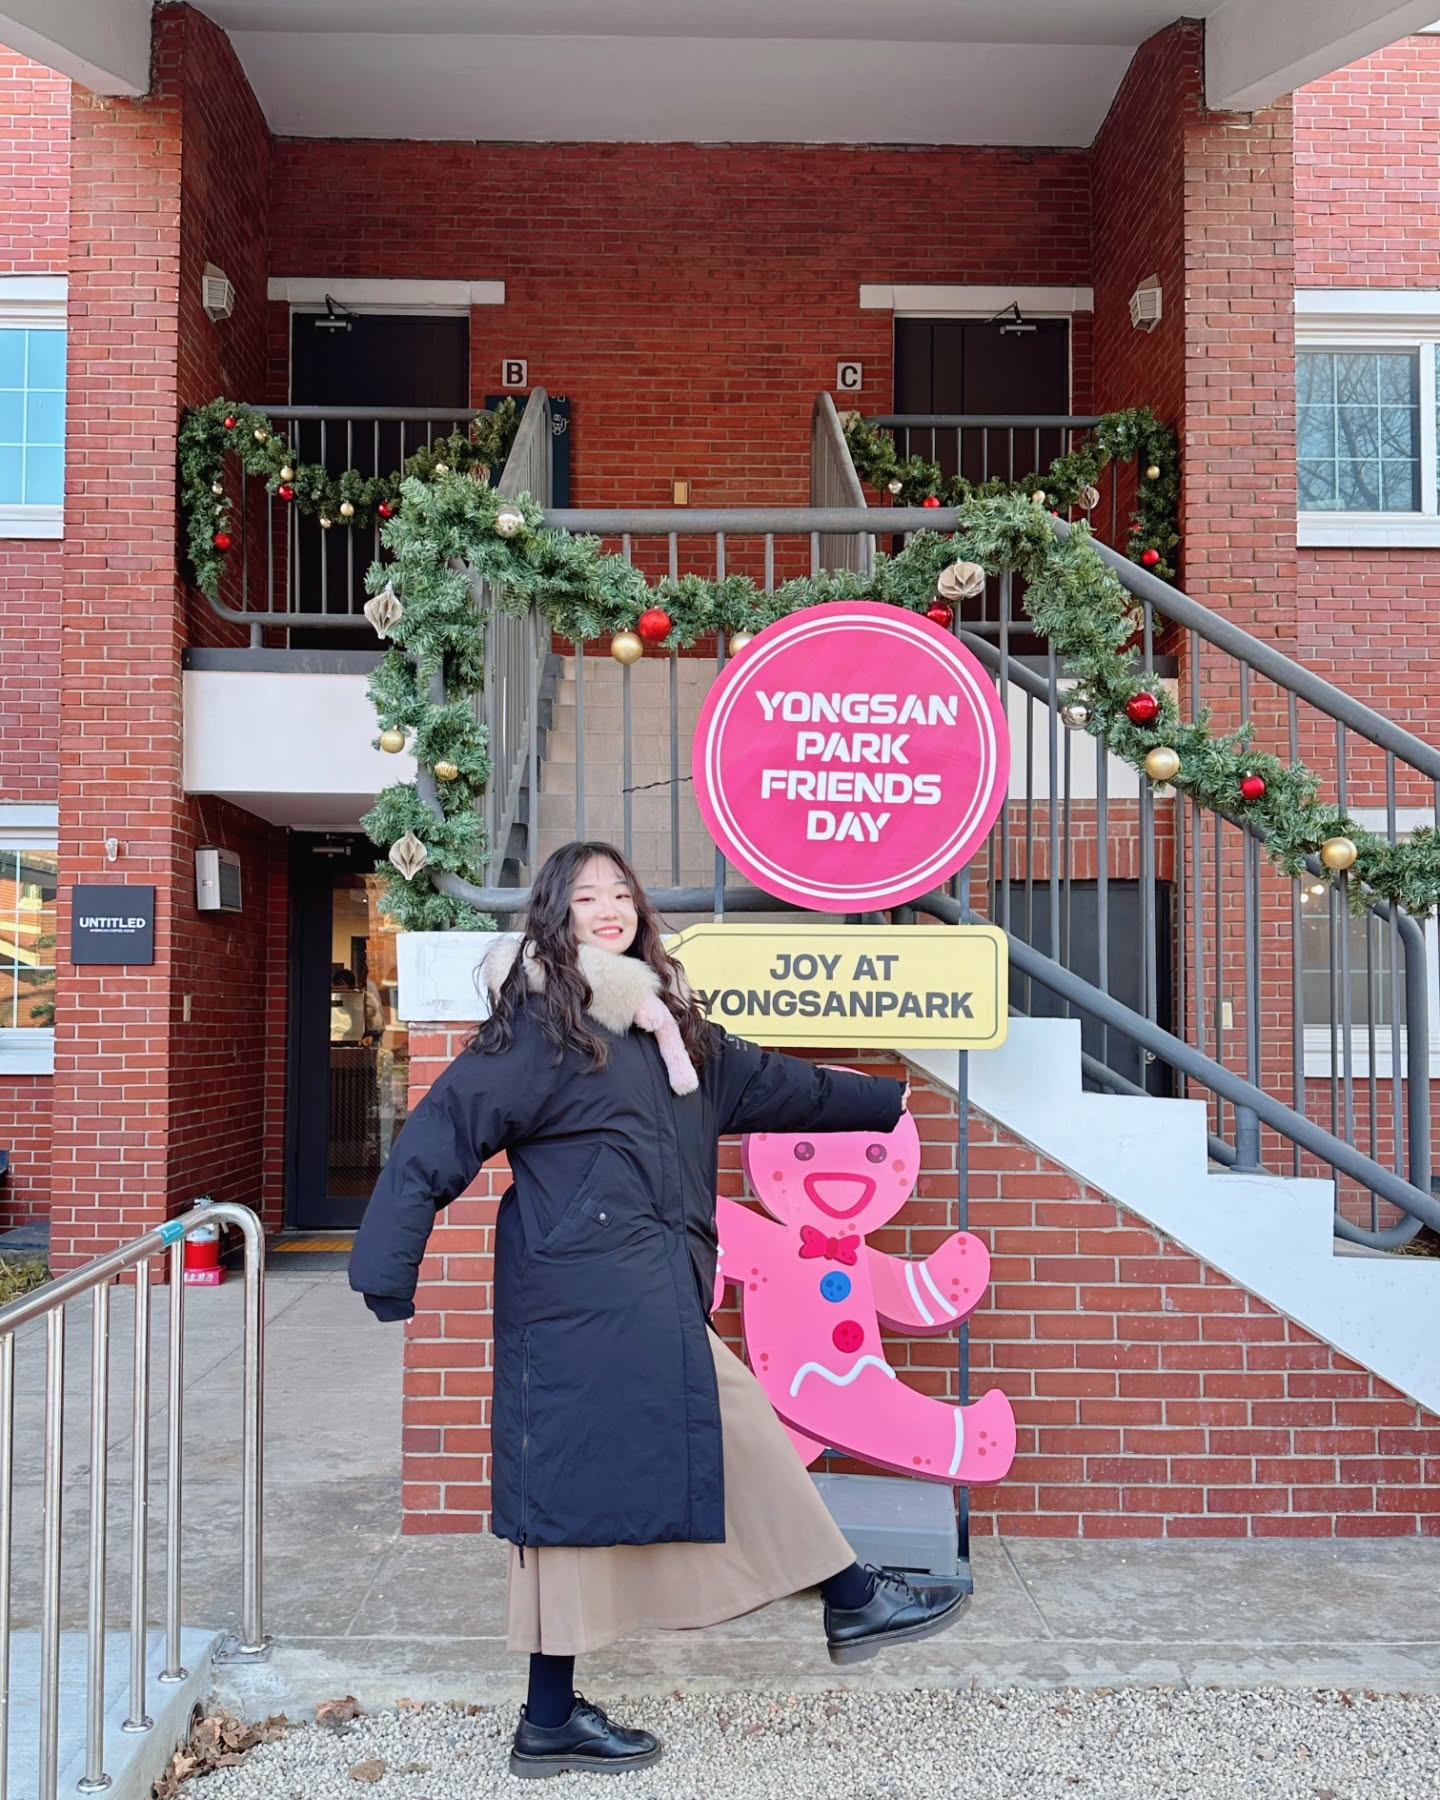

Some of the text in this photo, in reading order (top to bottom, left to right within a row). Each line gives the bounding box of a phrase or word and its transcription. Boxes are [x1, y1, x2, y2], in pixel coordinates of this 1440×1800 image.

[506, 362, 523, 384] B
[841, 365, 858, 388] C
[755, 690, 958, 726] YONGSAN
[796, 731, 911, 764] PARK
[761, 769, 942, 805] FRIENDS
[806, 810, 891, 842] DAY
[79, 917, 146, 928] UNTITLED
[769, 954, 899, 981] JOY AT
[698, 989, 974, 1019] YONGSANPARK
